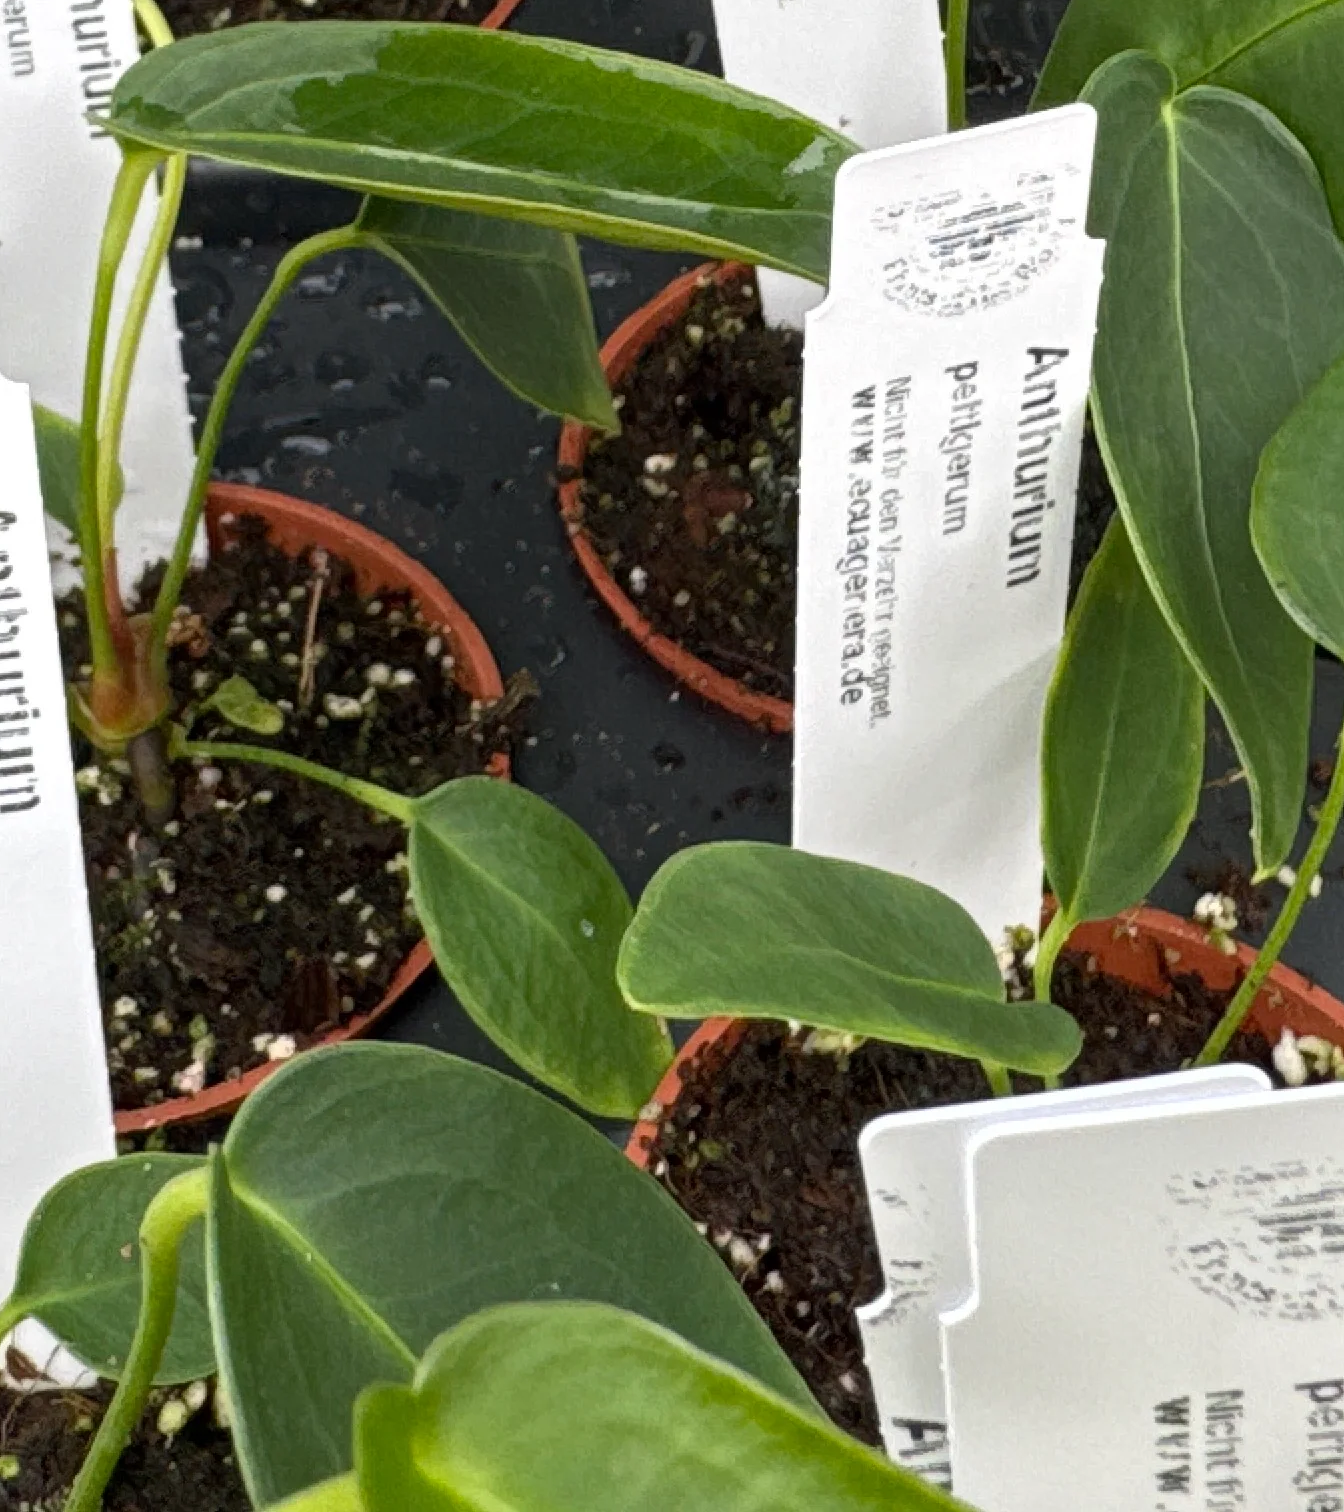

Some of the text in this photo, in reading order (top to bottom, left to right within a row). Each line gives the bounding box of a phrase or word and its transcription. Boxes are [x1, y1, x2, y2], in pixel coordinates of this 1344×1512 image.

[836, 384, 877, 707] www.ecuagenera.de
[938, 360, 984, 537] peltigerum
[1006, 347, 1069, 588] Anthurium
[1204, 1389, 1245, 1473] Nicht
